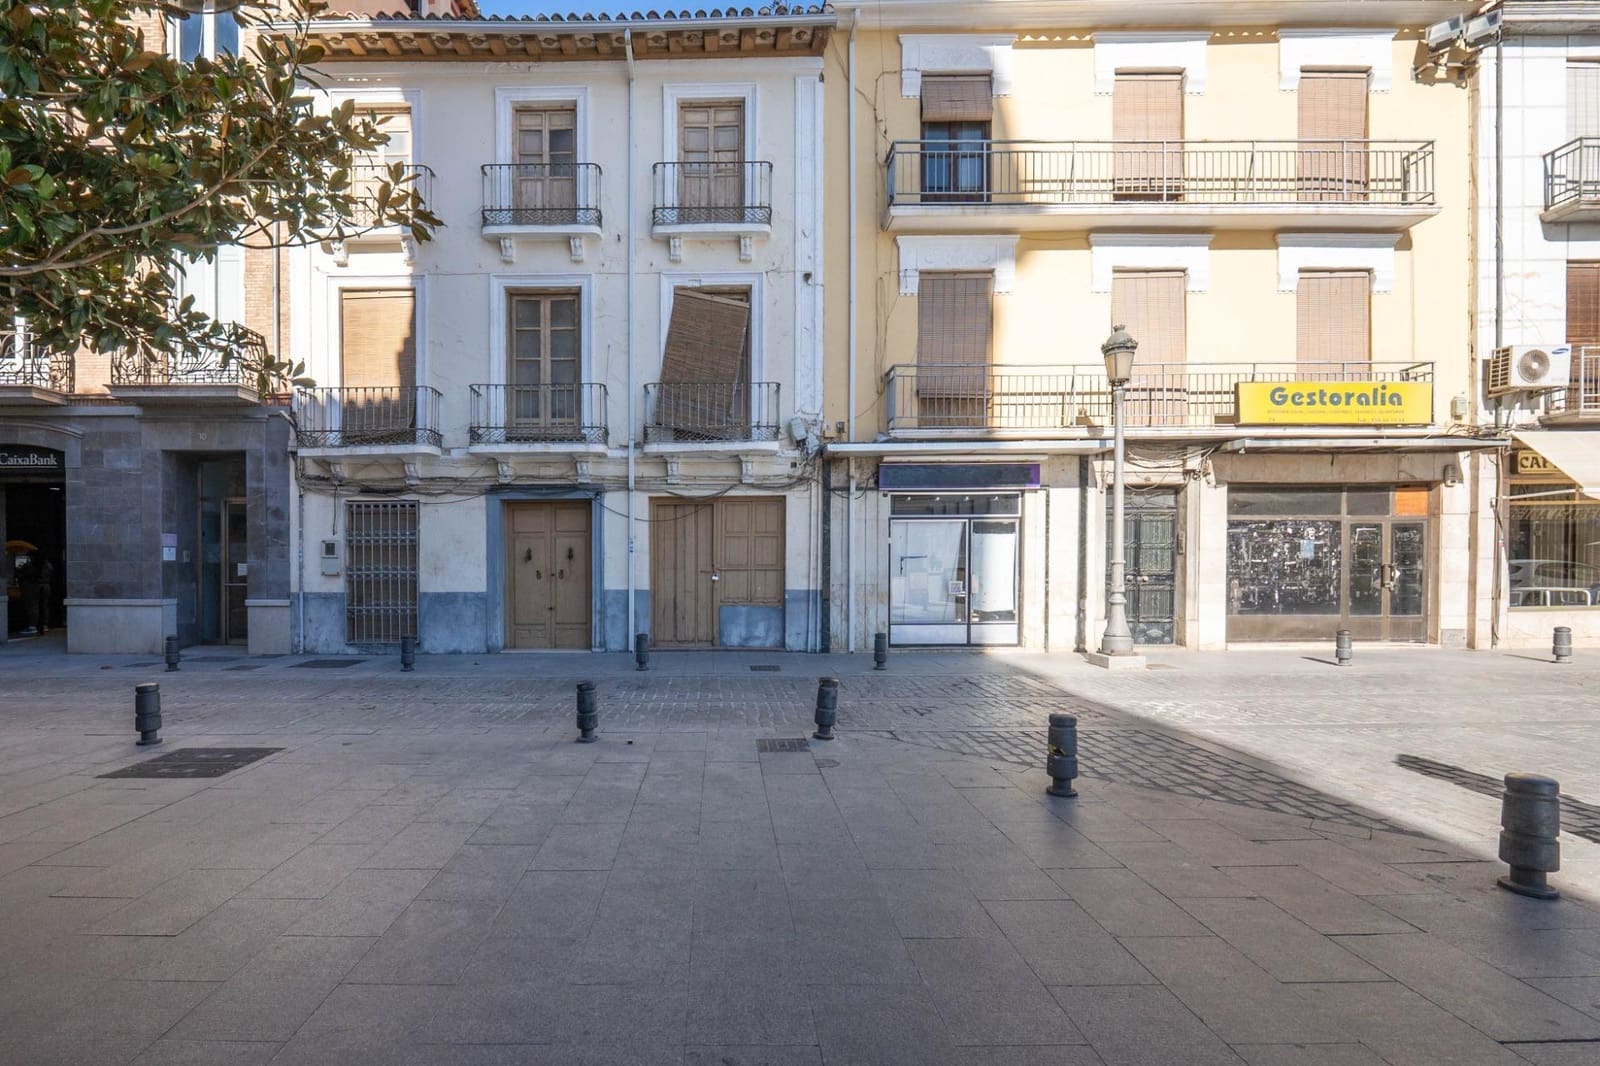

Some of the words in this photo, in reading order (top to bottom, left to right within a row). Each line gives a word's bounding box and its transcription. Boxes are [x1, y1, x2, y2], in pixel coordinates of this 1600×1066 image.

[1269, 384, 1403, 407] Gestoralia
[199, 433, 207, 441] 10
[0, 453, 58, 465] CaixaBank
[1520, 456, 1557, 469] CAF
